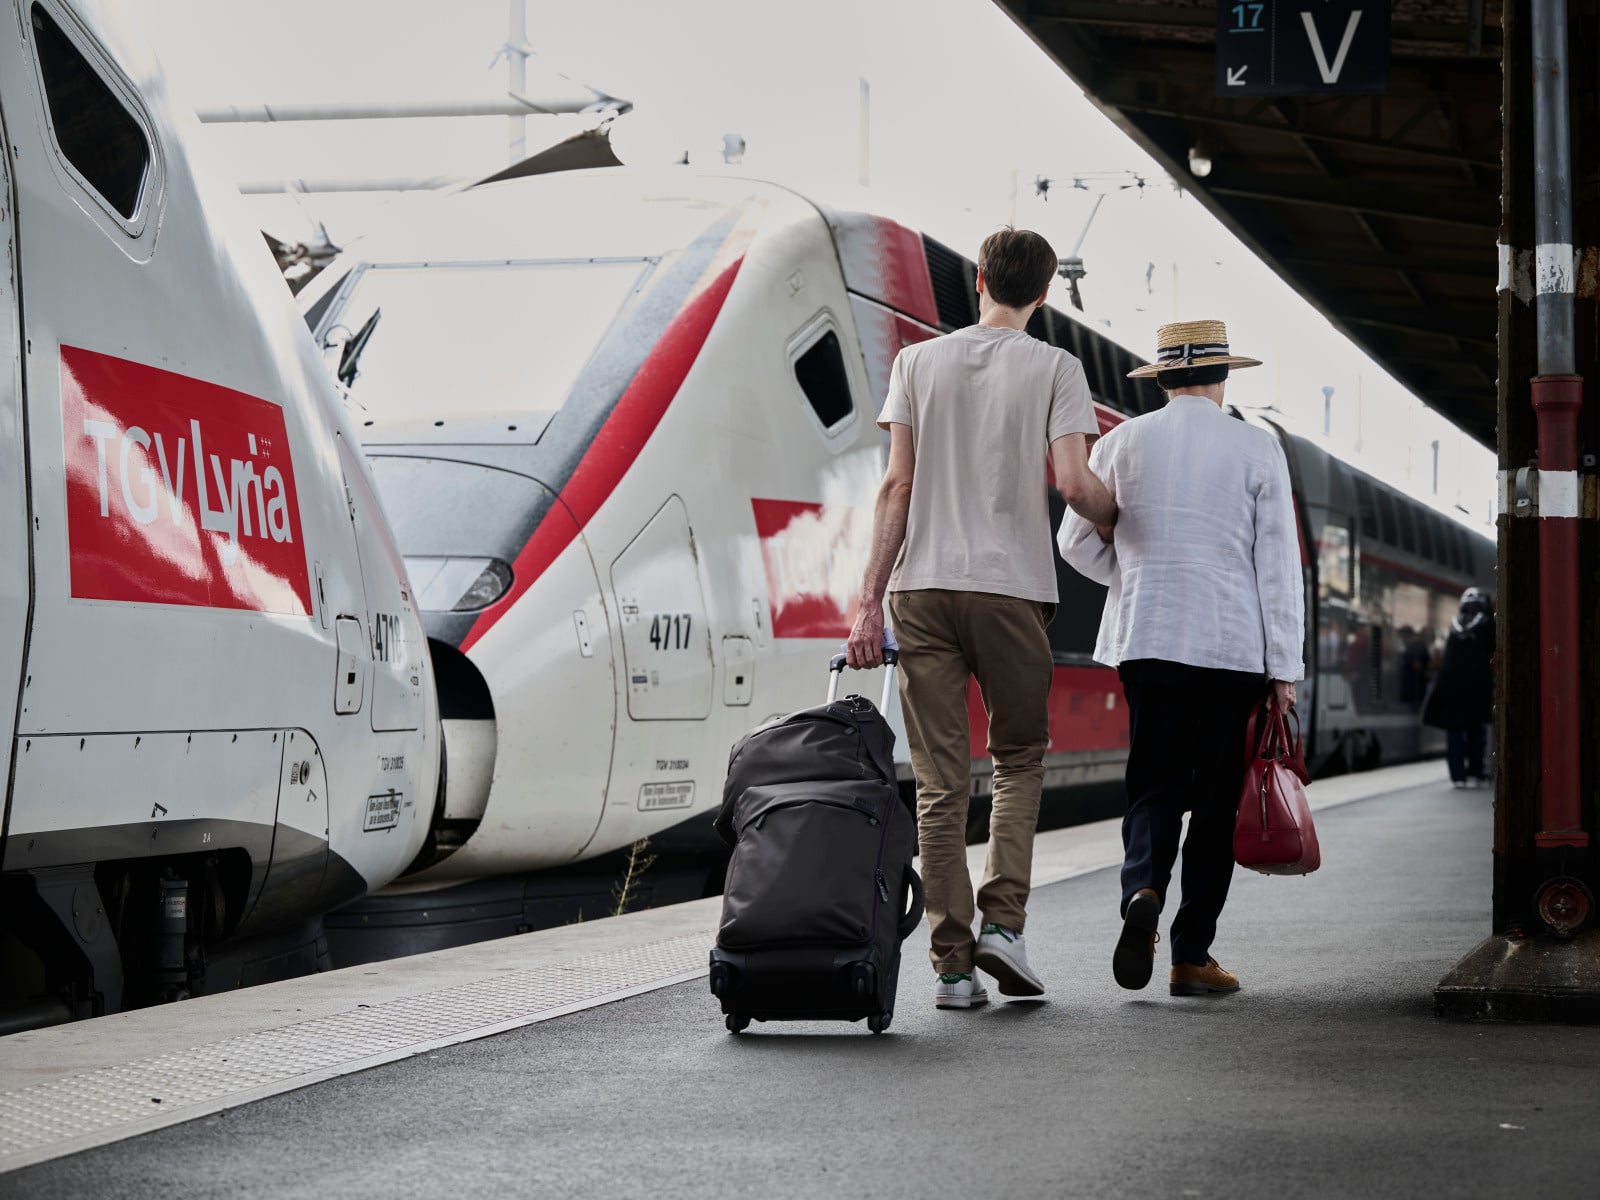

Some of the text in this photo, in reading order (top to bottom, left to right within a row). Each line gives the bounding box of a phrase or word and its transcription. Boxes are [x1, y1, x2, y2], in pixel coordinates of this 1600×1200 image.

[1231, 4, 1264, 28] 17
[1300, 10, 1363, 84] V
[84, 418, 293, 566] TGV Lyria
[650, 613, 692, 651] 4717
